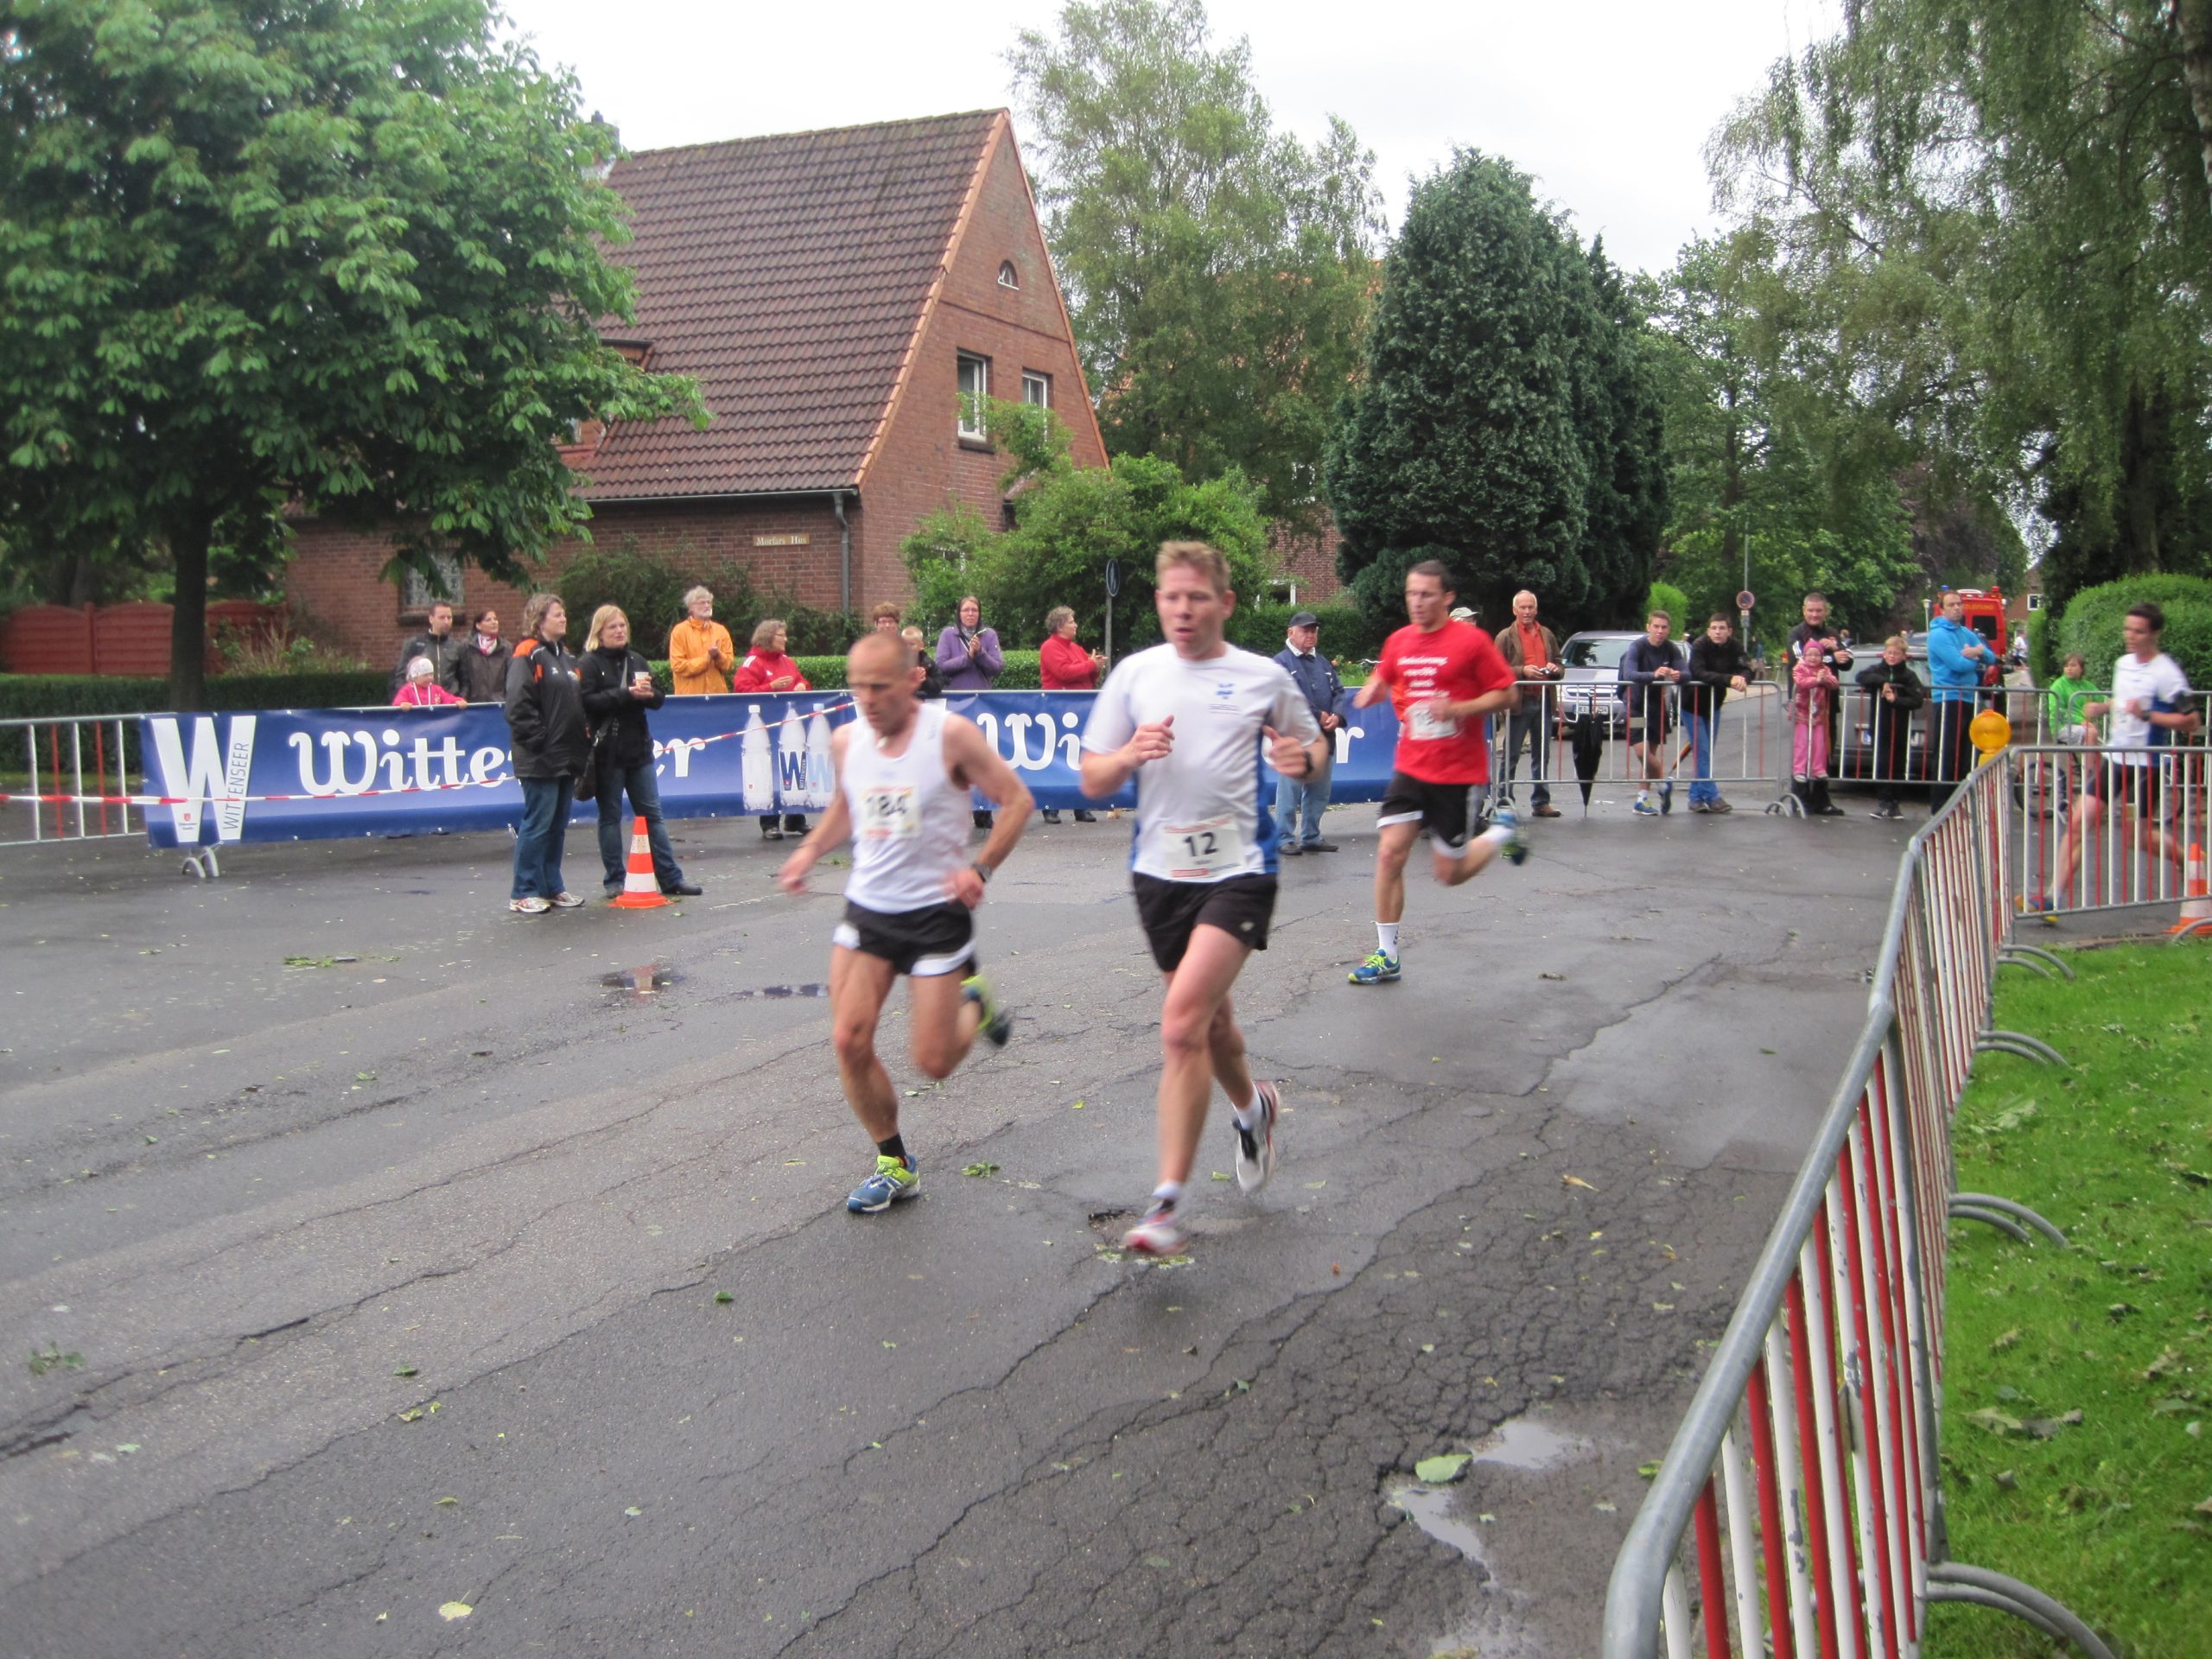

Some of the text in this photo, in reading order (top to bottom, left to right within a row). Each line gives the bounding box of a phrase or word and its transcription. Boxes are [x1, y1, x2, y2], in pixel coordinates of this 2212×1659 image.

[791, 536, 807, 544] Hus
[150, 715, 257, 842] W
[1183, 831, 1219, 857] 12
